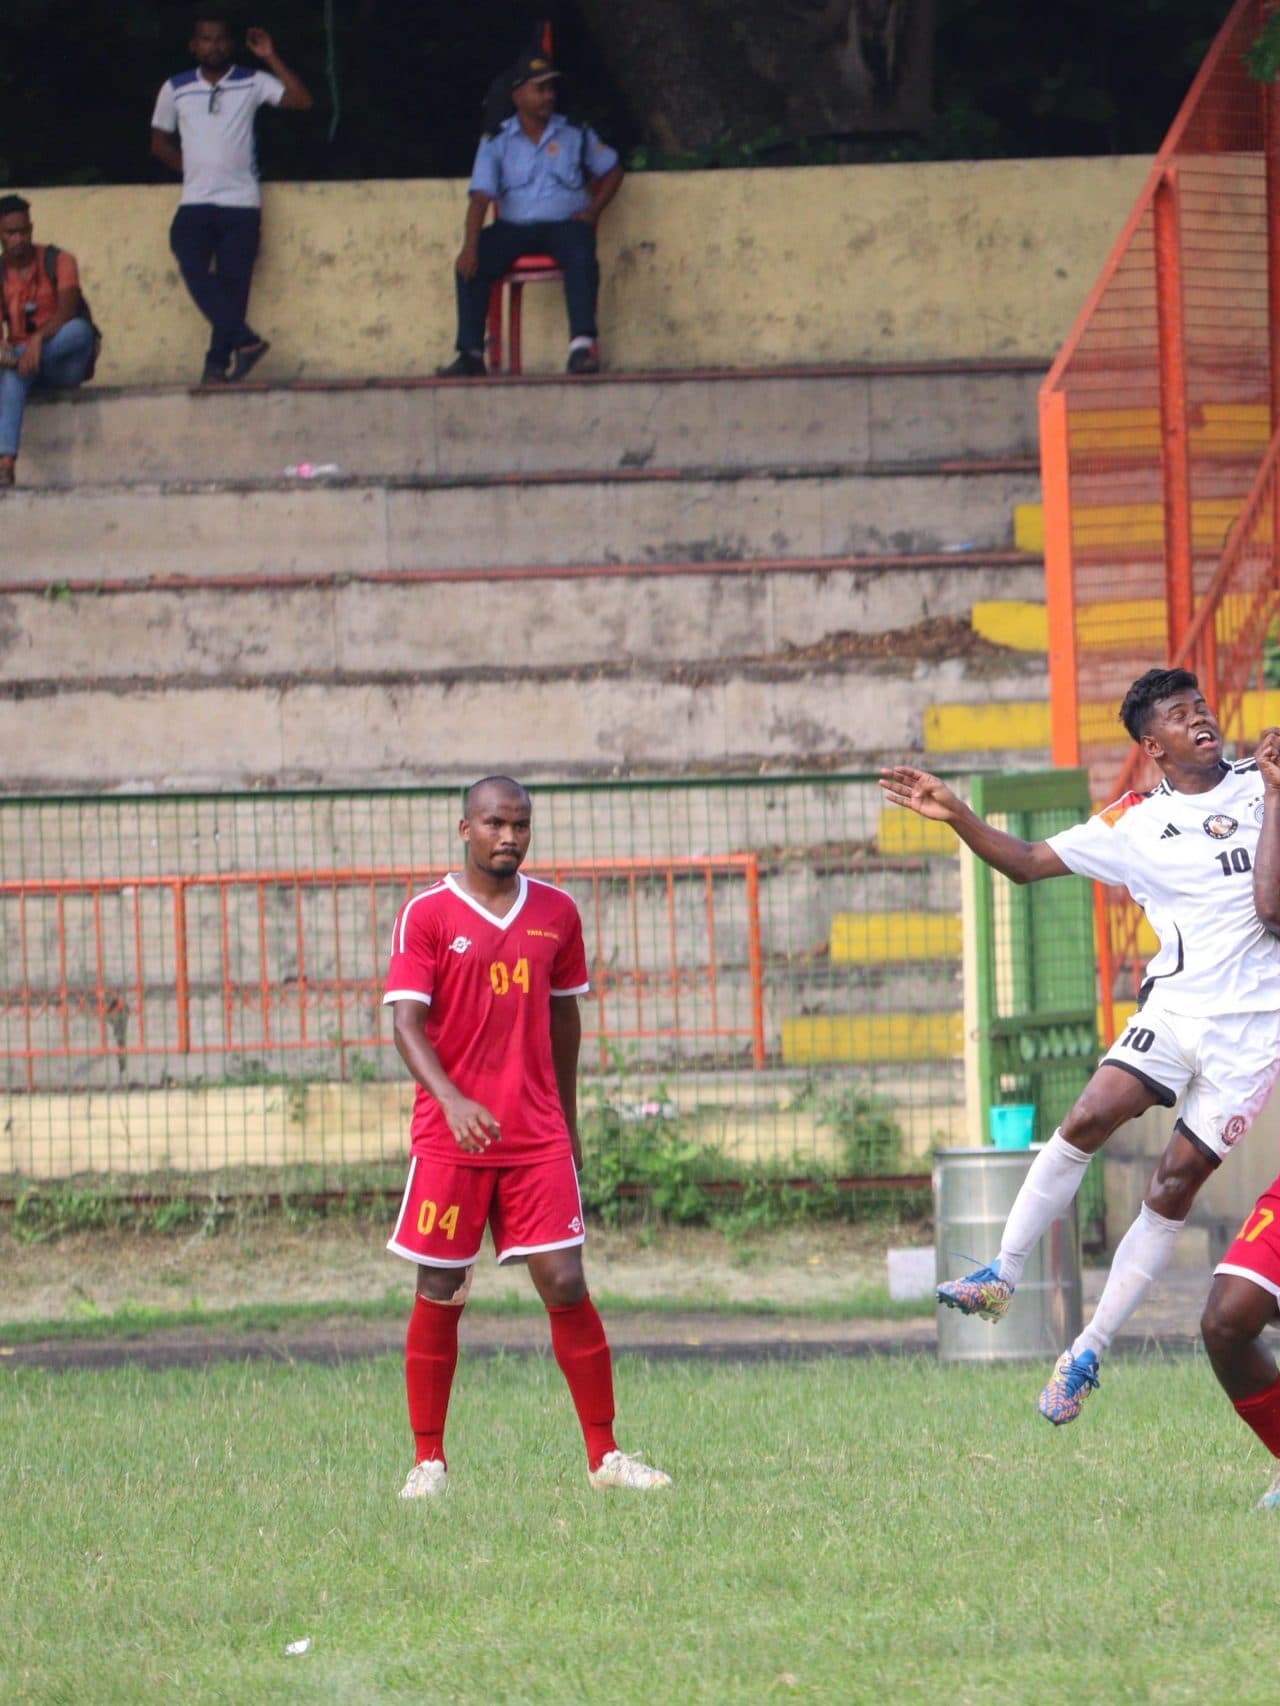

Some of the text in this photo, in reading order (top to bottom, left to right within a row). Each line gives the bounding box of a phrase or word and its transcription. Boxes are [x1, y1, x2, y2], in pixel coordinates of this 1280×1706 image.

[1214, 847, 1252, 877] 10
[489, 957, 529, 995] 04
[1120, 1025, 1156, 1053] 10
[416, 1199, 460, 1241] 04
[1235, 1207, 1275, 1243] 17
